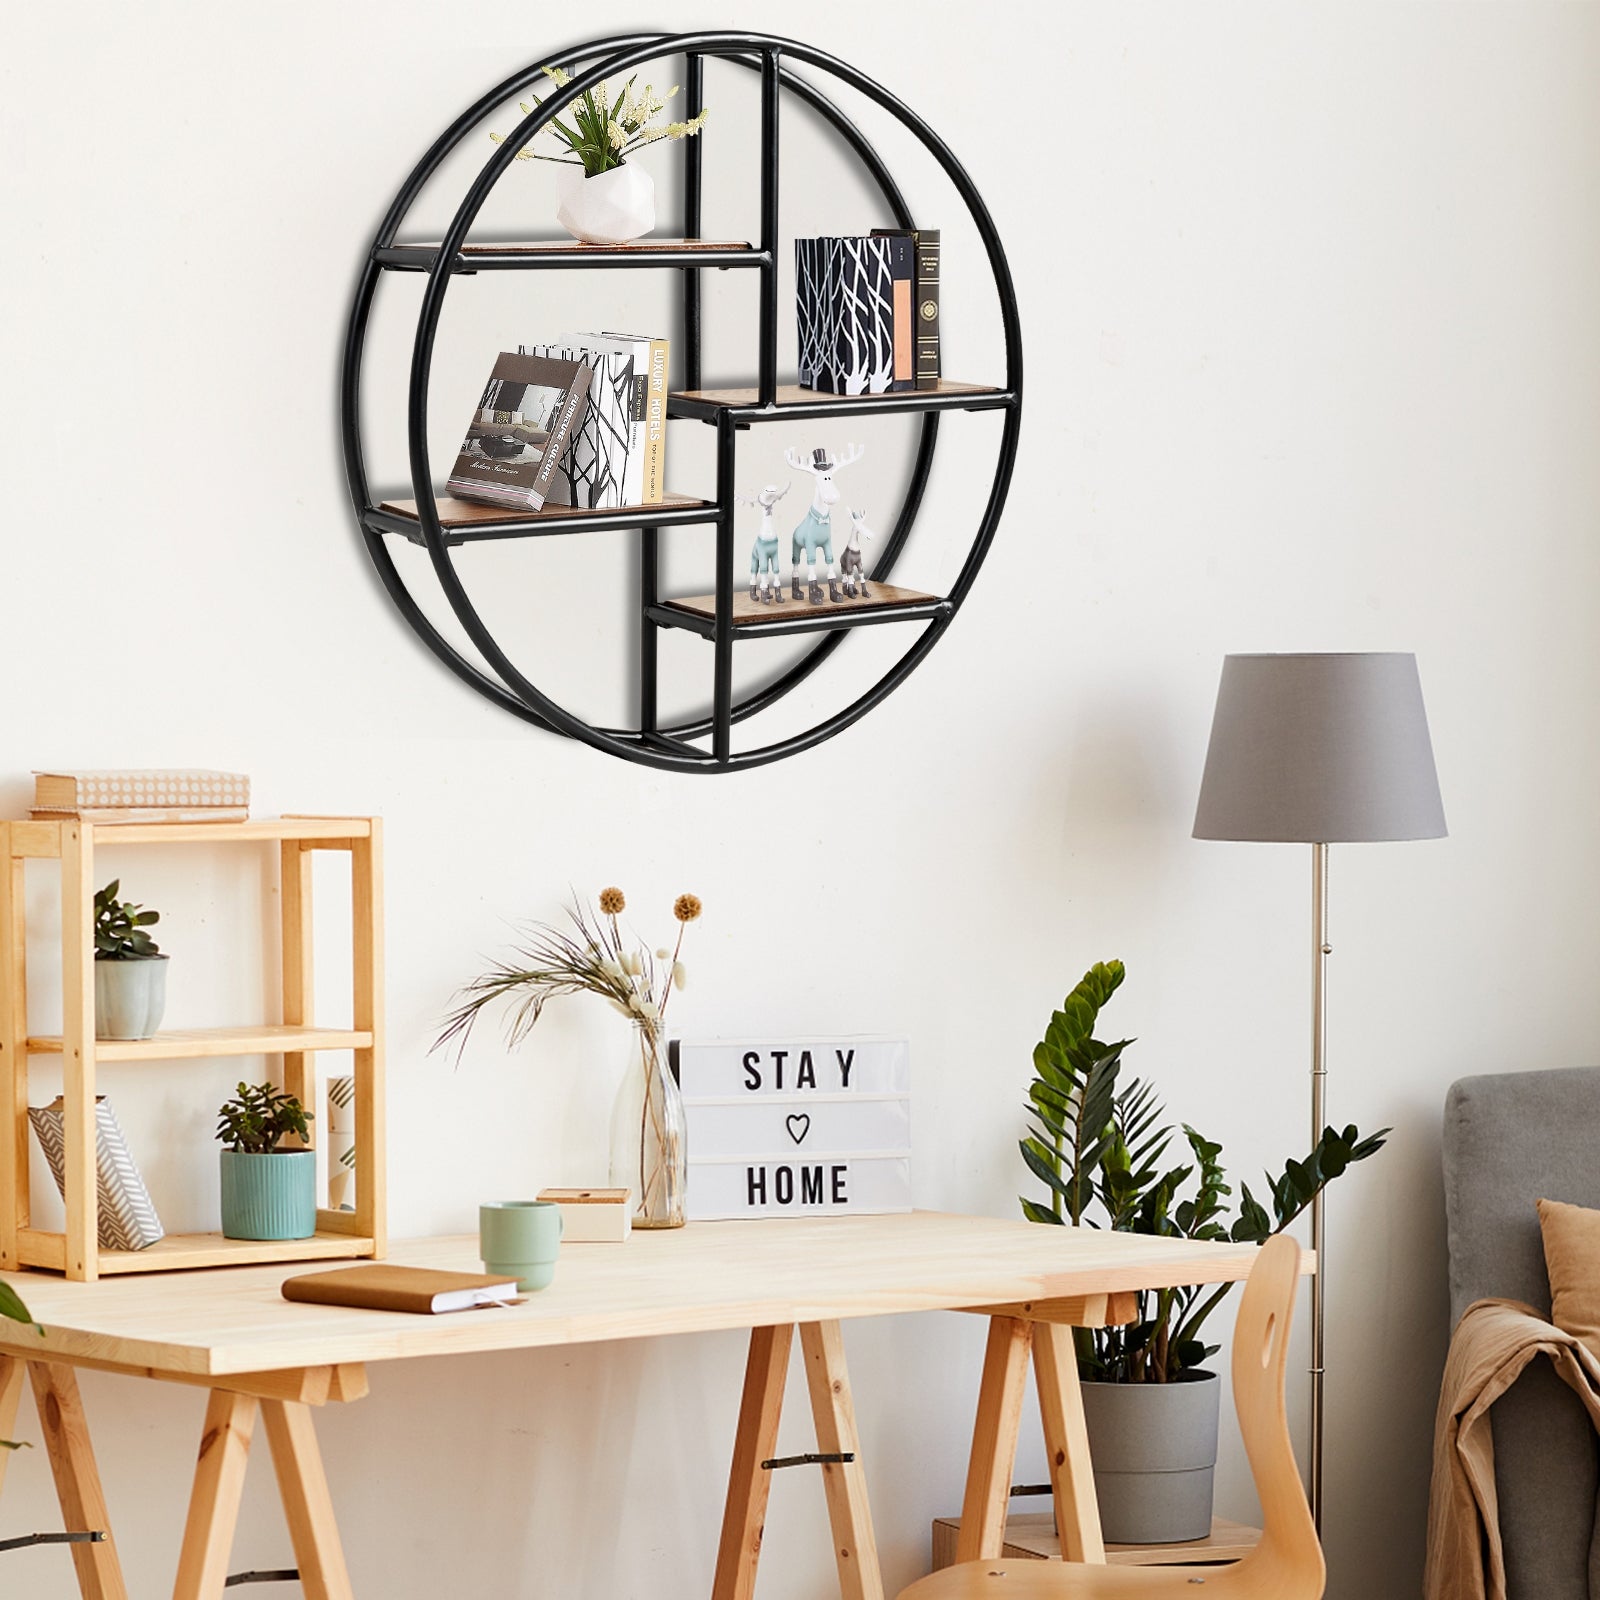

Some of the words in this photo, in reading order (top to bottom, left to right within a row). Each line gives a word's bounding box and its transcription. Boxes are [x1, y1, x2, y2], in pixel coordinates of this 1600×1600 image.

[652, 348, 665, 393] LUXURY
[650, 398, 663, 441] HOTELS
[742, 1049, 855, 1090] STAY
[747, 1165, 848, 1205] HOME
